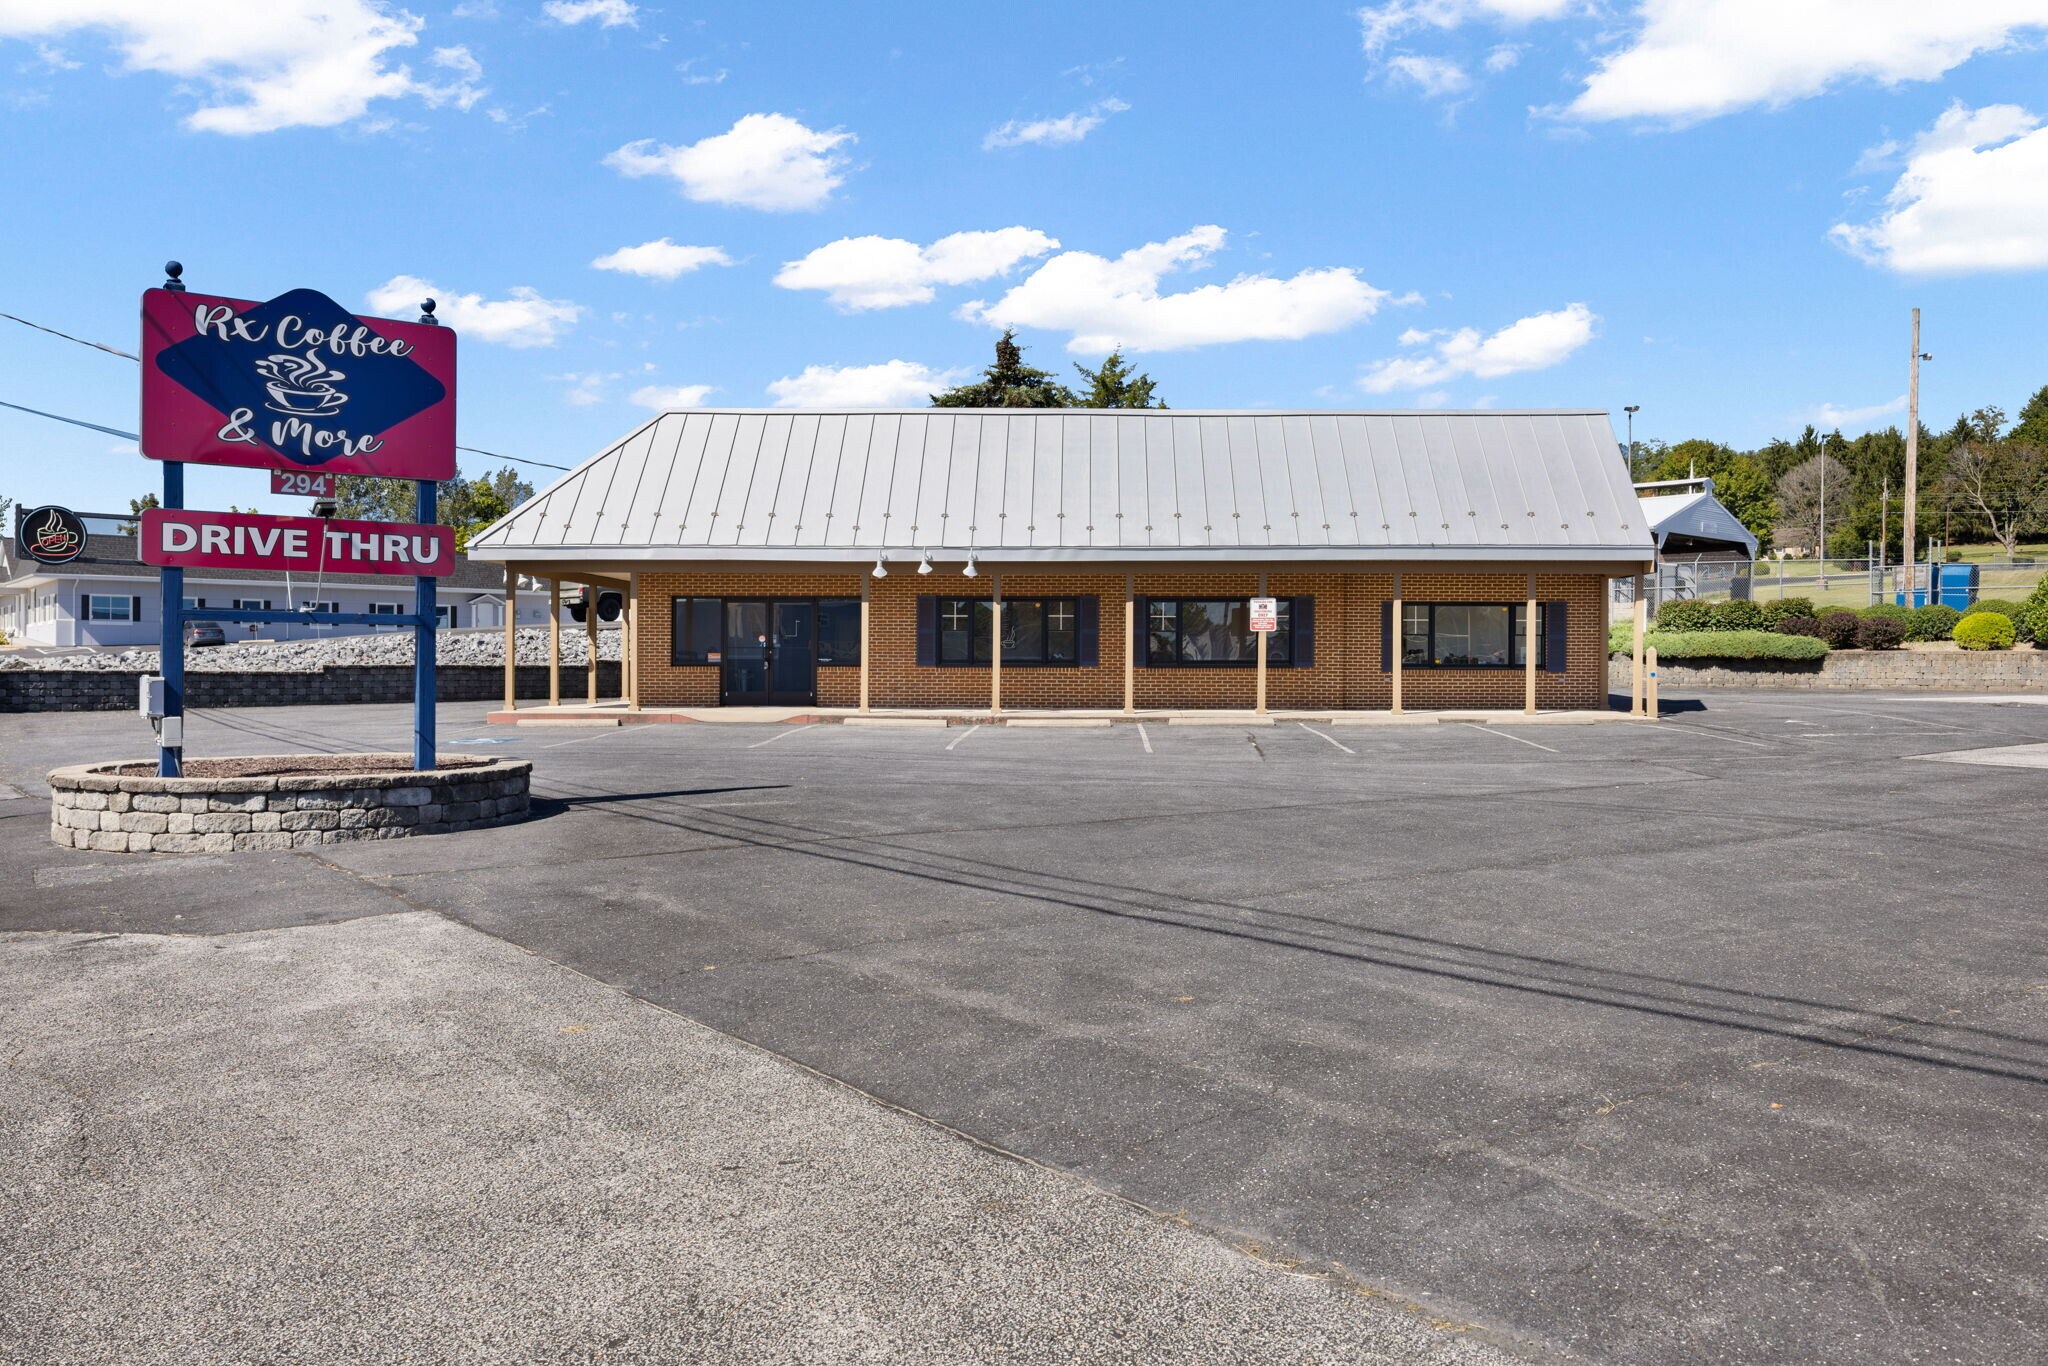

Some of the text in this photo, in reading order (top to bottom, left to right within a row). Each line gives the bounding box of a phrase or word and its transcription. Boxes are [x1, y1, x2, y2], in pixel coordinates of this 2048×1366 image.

[194, 304, 414, 357] Rx Coffee
[217, 408, 384, 457] & More
[281, 473, 327, 495] 294
[41, 534, 66, 546] OPEN
[161, 522, 440, 564] DRIVE THRU
